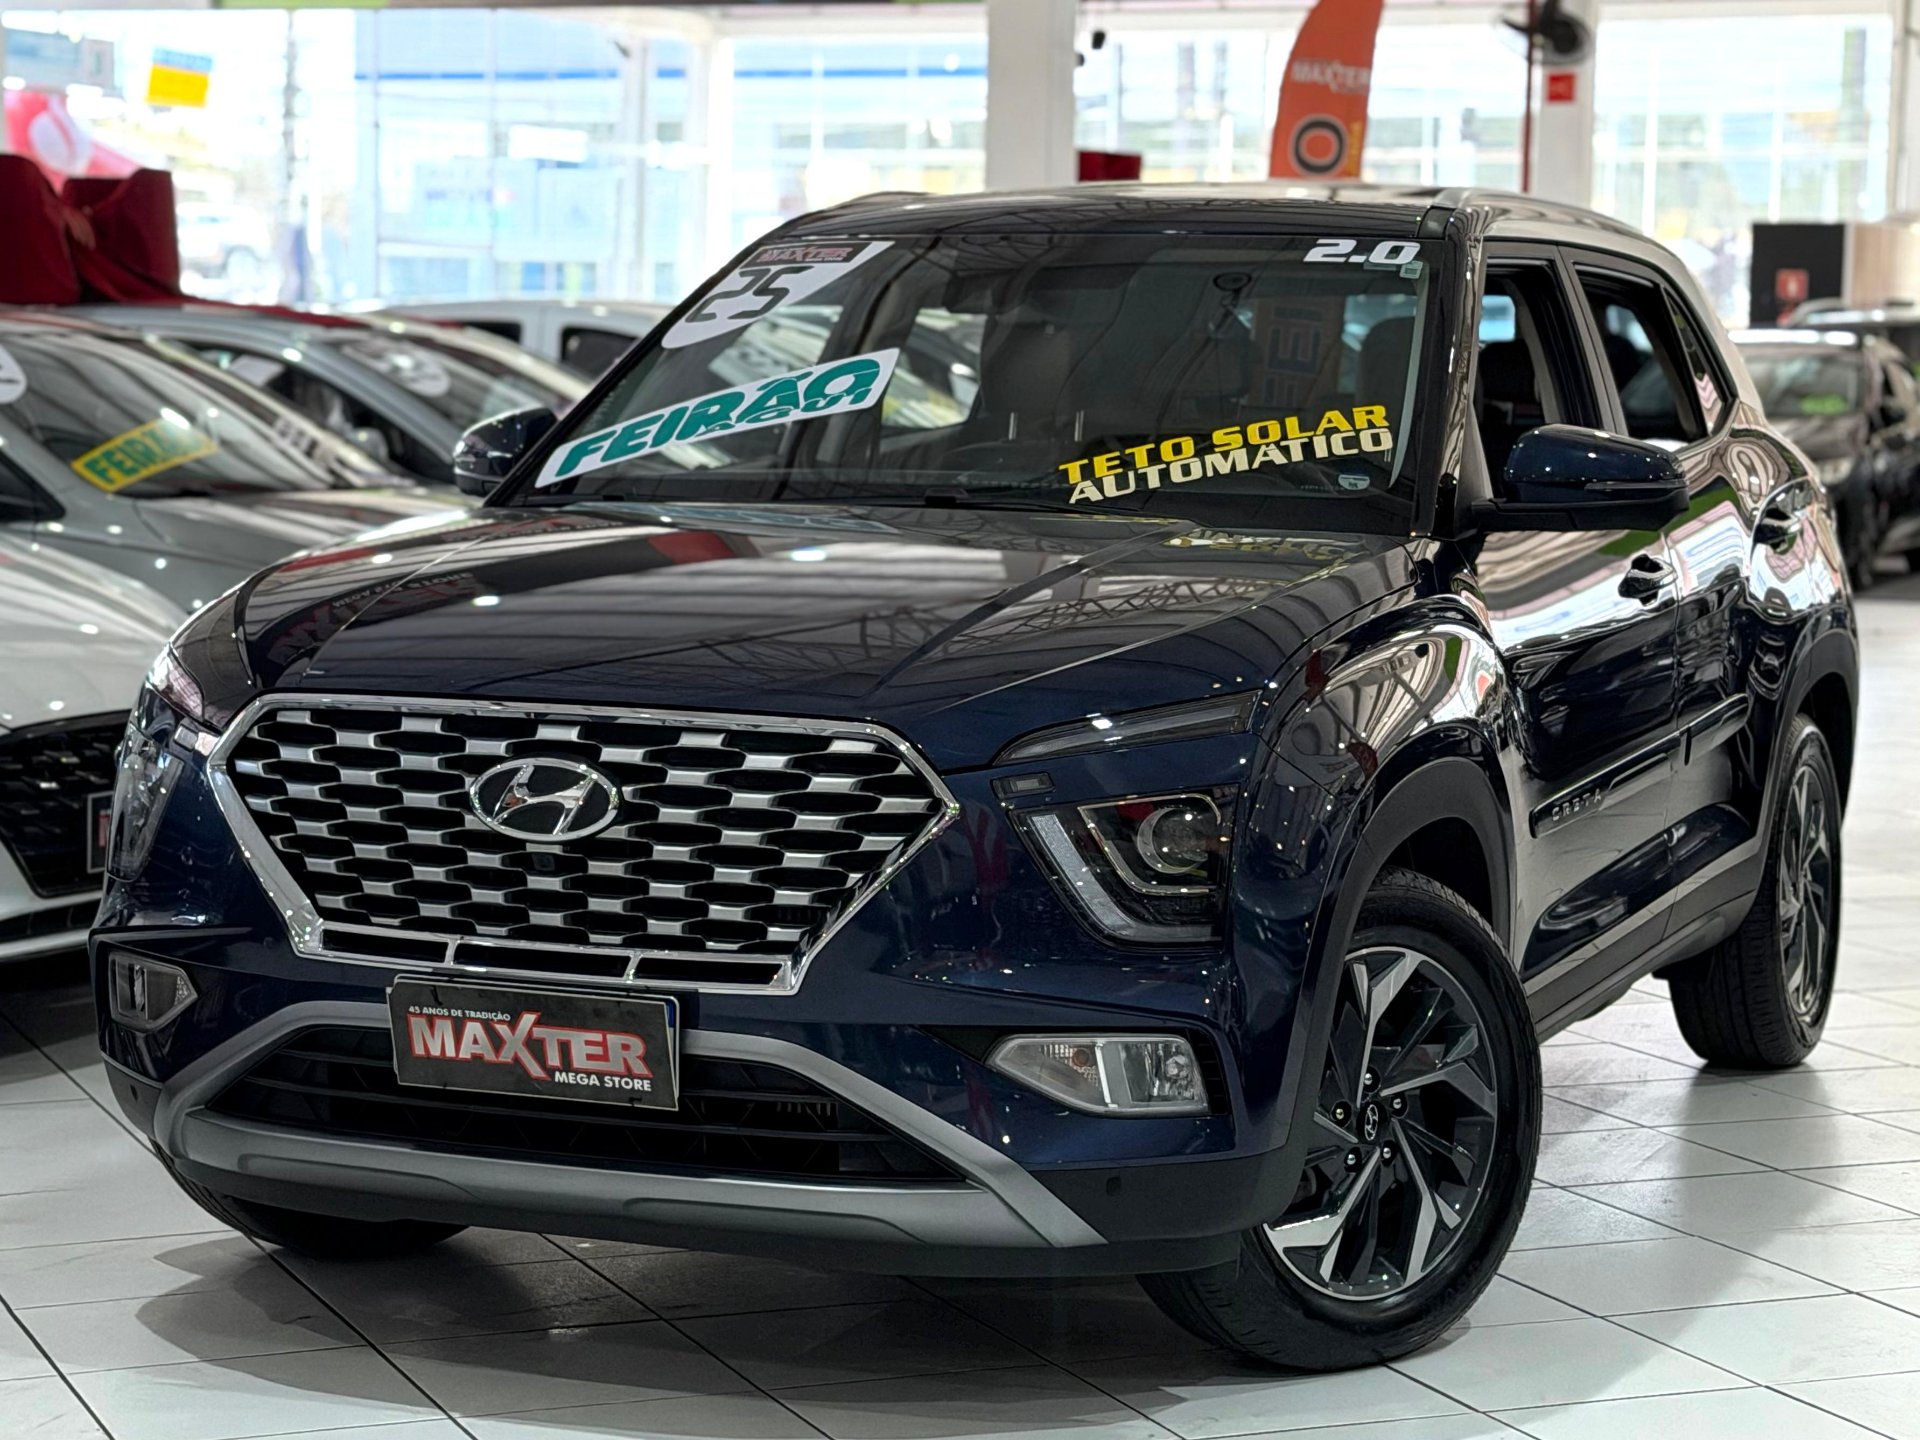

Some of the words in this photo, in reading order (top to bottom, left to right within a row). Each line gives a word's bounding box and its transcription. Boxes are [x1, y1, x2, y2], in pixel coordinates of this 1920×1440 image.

[1303, 239, 1420, 264] 2.0
[685, 265, 815, 323] 25
[1059, 436, 1196, 485] TETO
[1212, 405, 1390, 452] SOLAR
[1552, 788, 1602, 821] CRETA
[408, 1005, 420, 1014] 45
[422, 1006, 449, 1016] ANOS
[450, 1008, 463, 1017] DE
[464, 1010, 511, 1022] TRADIÇÃO
[407, 1011, 653, 1081] MAXTER
[554, 1070, 600, 1087] MEGA
[603, 1075, 652, 1092] STORE
